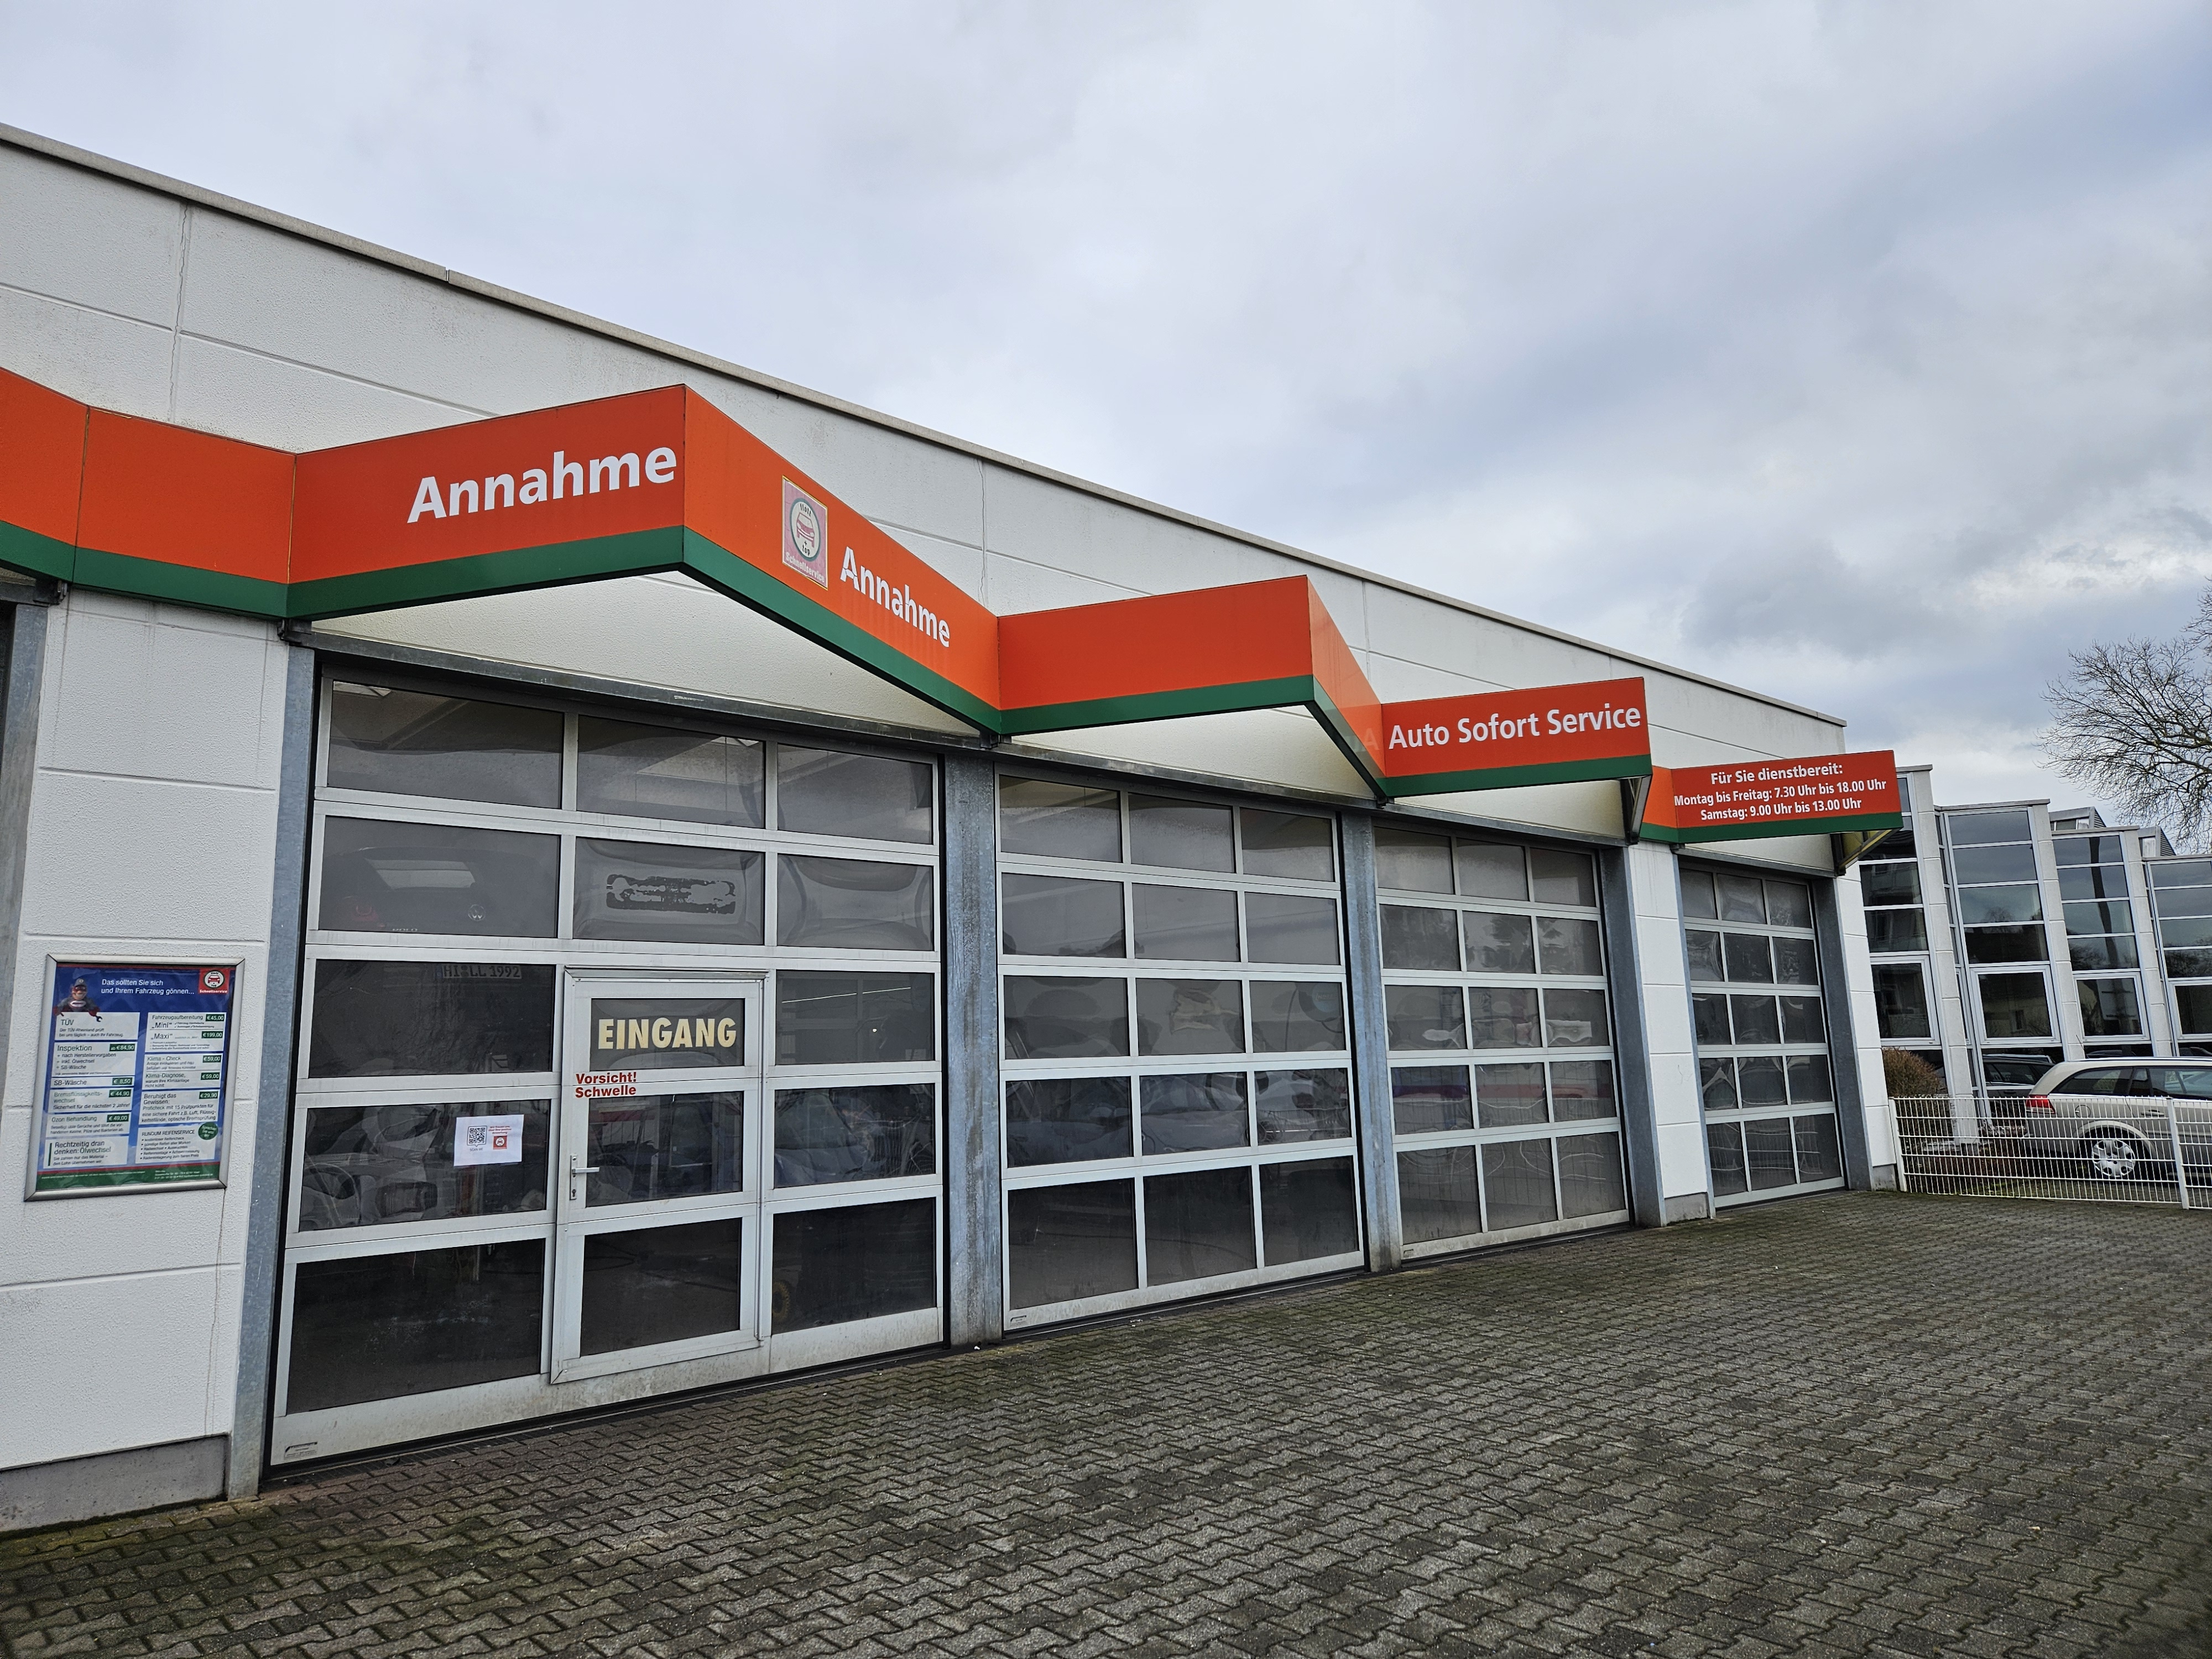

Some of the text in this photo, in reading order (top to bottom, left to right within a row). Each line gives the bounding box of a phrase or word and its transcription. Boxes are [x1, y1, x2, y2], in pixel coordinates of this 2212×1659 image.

[407, 446, 677, 523] Annahme
[786, 552, 825, 582] Schnellservice
[839, 546, 950, 648] Annahme
[1389, 703, 1641, 750] Auto Sofort Service
[1711, 763, 1843, 785] Für Sie dienstbereit:
[1674, 779, 1886, 806] Montag bis Freitag: 7.30 Uhr bis 18.00 Uhr
[1701, 797, 1861, 821] Samstag: 9.00 Uhr bis 13.00 Uhr
[445, 965, 520, 977] HI LL 1992
[598, 1018, 735, 1049] EINGANG
[575, 1085, 636, 1098] Schwelle
[576, 1072, 637, 1084] Vorsicht!
